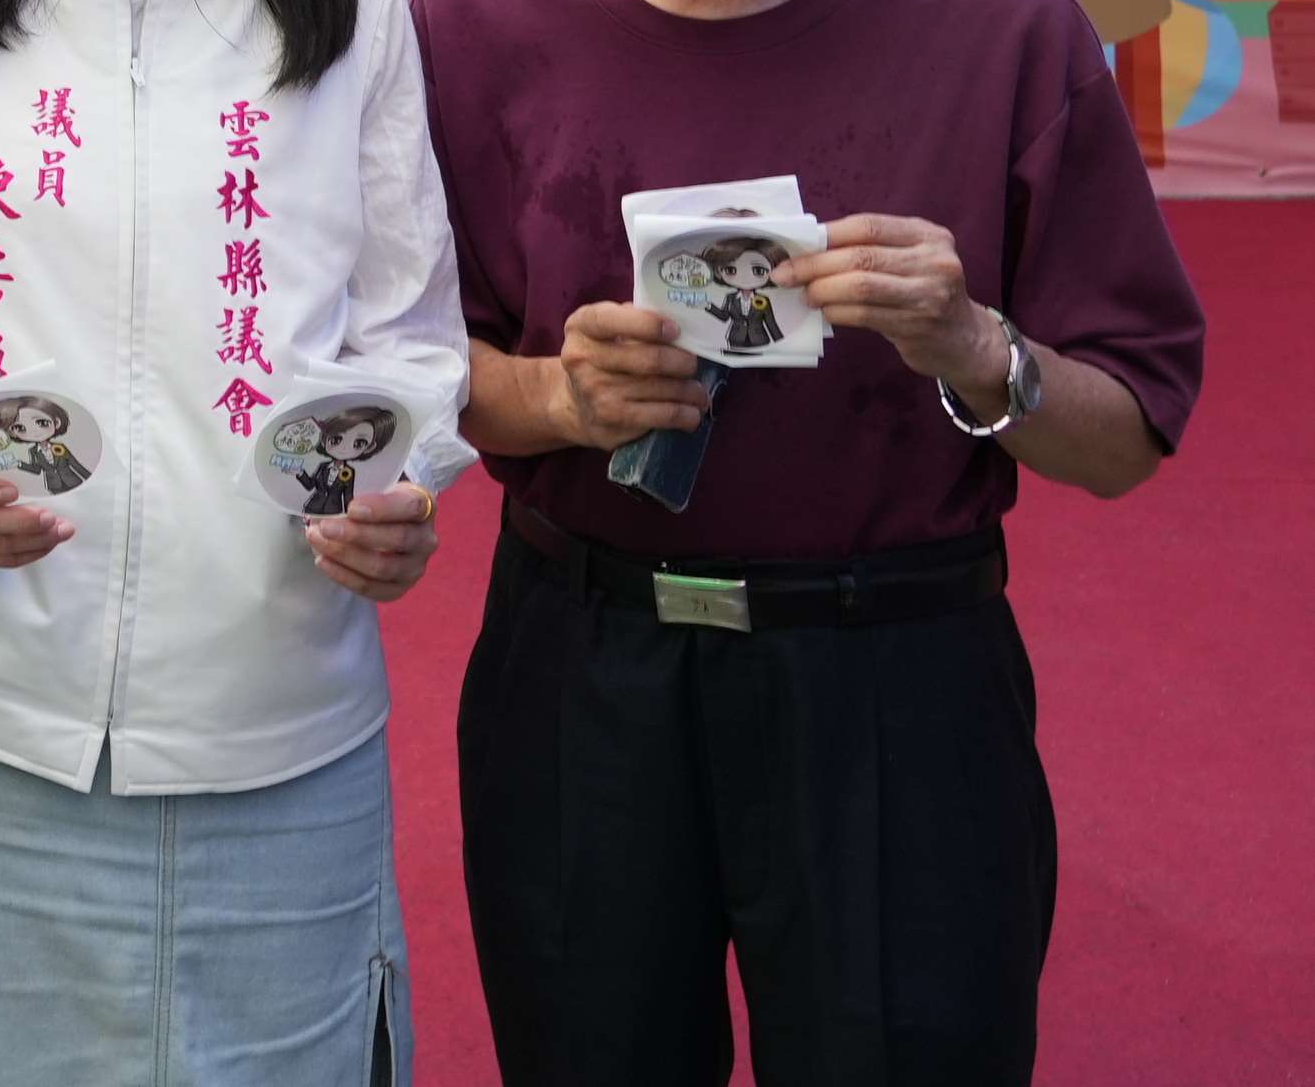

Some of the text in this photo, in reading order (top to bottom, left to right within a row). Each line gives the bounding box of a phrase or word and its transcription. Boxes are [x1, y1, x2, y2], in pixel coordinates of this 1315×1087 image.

[30, 87, 82, 207] 議員
[212, 100, 274, 438] 雲林縣議會
